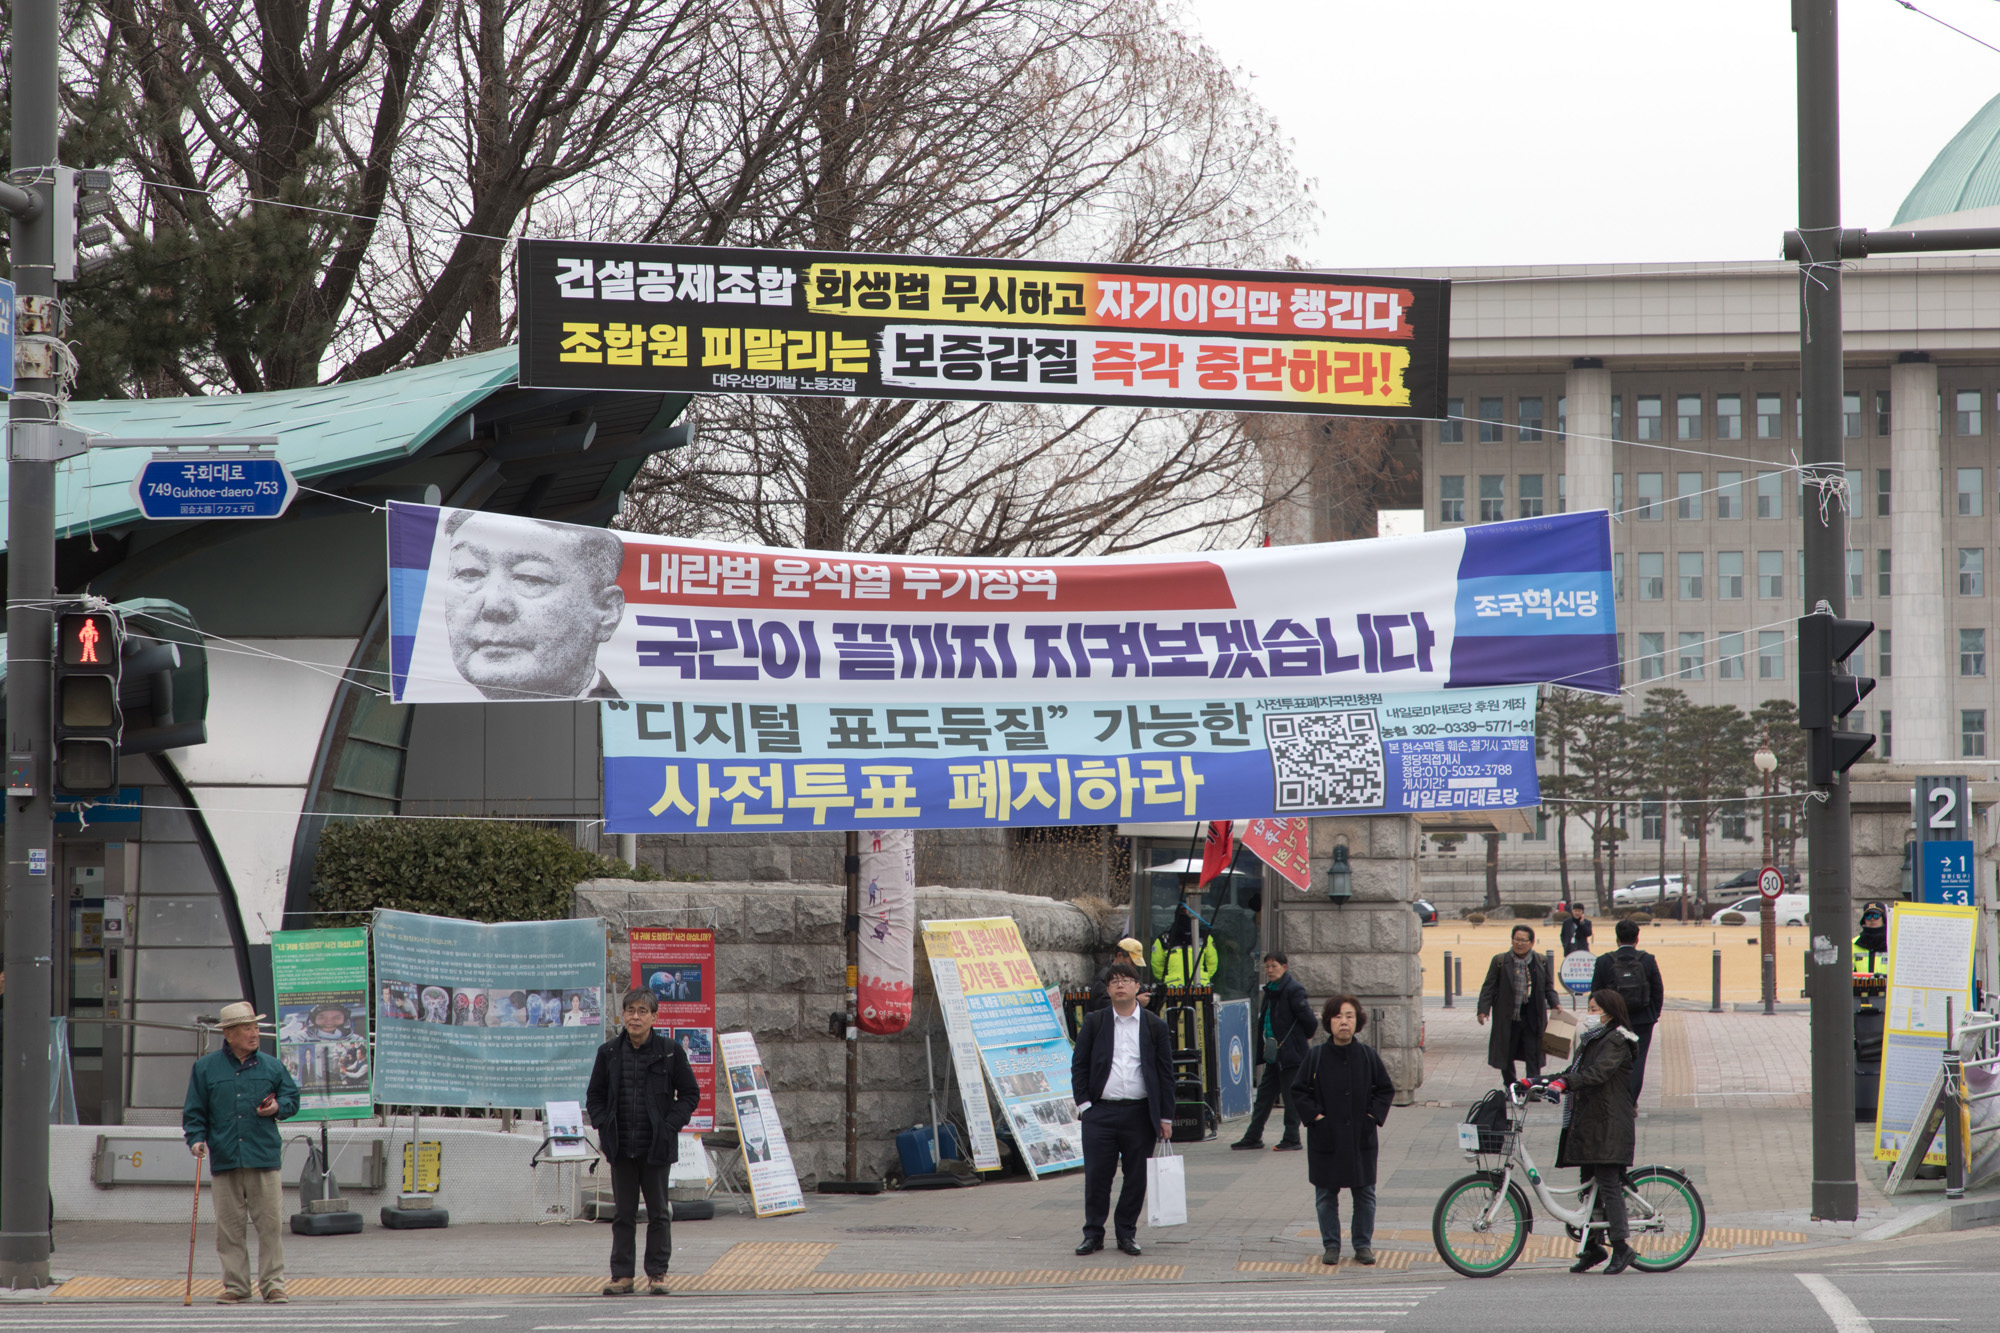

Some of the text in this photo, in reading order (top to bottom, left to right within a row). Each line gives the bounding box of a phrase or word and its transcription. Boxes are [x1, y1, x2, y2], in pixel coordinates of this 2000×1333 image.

[555, 257, 1402, 332] 건설공제조합 회생법 무시하고 자기이익만 챙긴다
[559, 321, 1393, 398] 조합원 피말리는 보증갑질 즉각 중단하라!
[712, 373, 857, 392] 대우산업개발 노동조합
[181, 464, 246, 483] 국회대로
[147, 481, 279, 499] 749 Gukhoe-daero 753
[180, 505, 212, 514] 国会大路
[640, 552, 1058, 601] 내란범 윤석열 무기징역
[1474, 588, 1599, 620] 조국혁신당
[635, 611, 1436, 681] 국민이 끝까지 지켜보겠습니다
[1256, 693, 1384, 711] 사전투표폐지국민청원
[1386, 697, 1527, 719] 내일로미래로당 후원 계좌
[1093, 702, 1253, 750] 가능한
[1381, 719, 1535, 739] 농협 302-0339-5771-91
[1388, 742, 1400, 754] 본
[1402, 740, 1445, 753] 현수막을
[1501, 739, 1529, 752] 고발함
[1401, 753, 1461, 766] 정당직접게시
[648, 755, 1205, 827] 사전투표 폐지하라
[1402, 778, 1445, 790] 게시기간:
[1402, 788, 1519, 809] 내일로미래로당
[1929, 787, 1956, 829] 2
[1958, 856, 1966, 872] 1
[1763, 876, 1779, 891] 30
[1957, 890, 1969, 906] 3
[131, 1151, 143, 1168] 6
